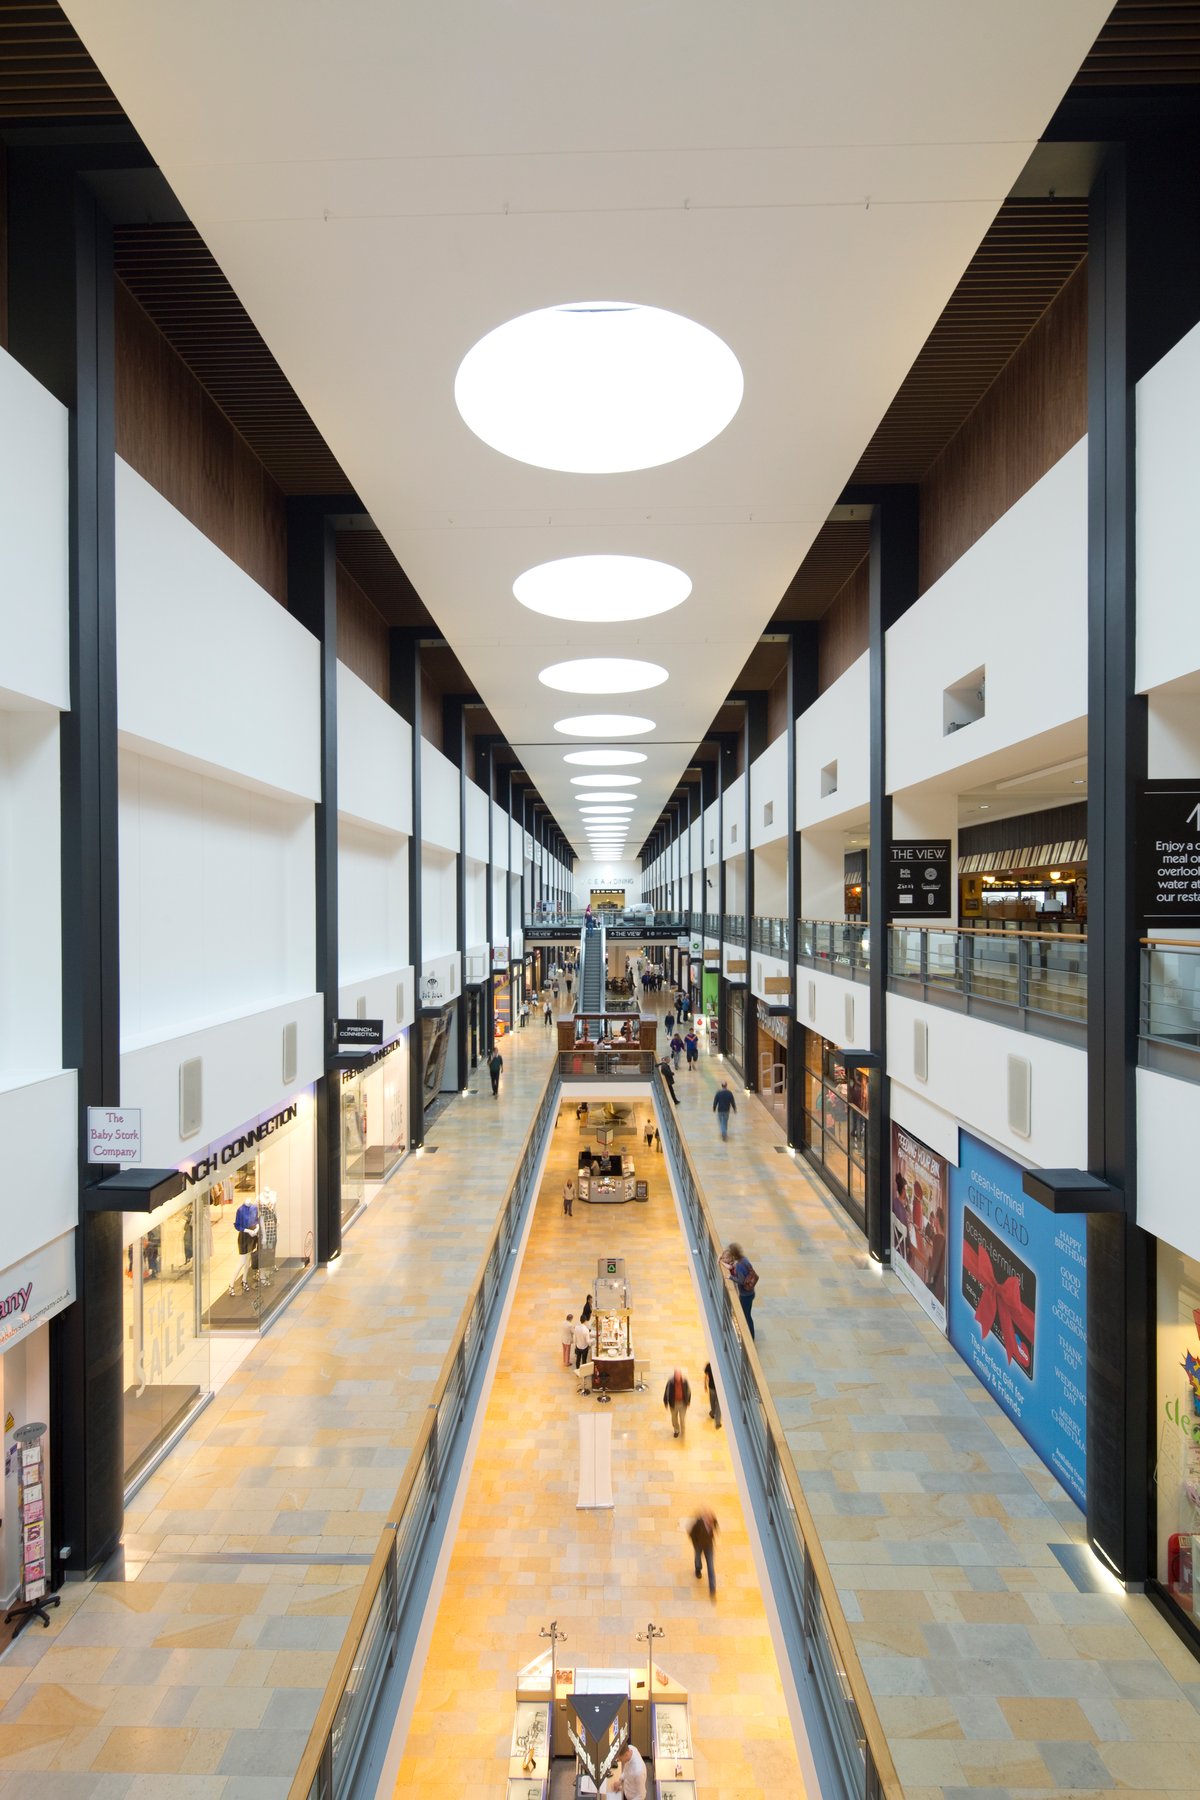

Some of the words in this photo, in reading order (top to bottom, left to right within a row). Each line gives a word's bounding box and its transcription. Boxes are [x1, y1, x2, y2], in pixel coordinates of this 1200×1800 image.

[892, 849, 914, 859] THE
[916, 849, 945, 859] VIEW
[1156, 841, 1185, 852] Enjoy
[1163, 853, 1188, 863] meal
[1158, 880, 1189, 889] water
[1156, 894, 1175, 902] our
[105, 1112, 124, 1123] The
[90, 1129, 113, 1142] Baby
[115, 1129, 139, 1140] Stork
[184, 1153, 217, 1186] NCH
[221, 1103, 297, 1165] CONNECTION
[93, 1145, 137, 1158] Company
[971, 1169, 1025, 1218] ocean-terminal
[968, 1185, 992, 1217] GIFT
[994, 1206, 1029, 1246] CARD
[1055, 1236, 1087, 1268] BIRTHDAY
[1059, 1229, 1082, 1253] HAPPY
[1060, 1266, 1081, 1288] GOOD
[1061, 1277, 1079, 1299] LUCK
[148, 1289, 173, 1335] THE
[1052, 1304, 1087, 1343] OCCASION
[1058, 1299, 1084, 1328] SPECIAL
[136, 1311, 185, 1399] SALE
[1058, 1334, 1083, 1366] THANK
[1063, 1350, 1077, 1370] YOU
[970, 1332, 981, 1352] The
[982, 1345, 1002, 1379] Perfect
[1002, 1372, 1014, 1393] Gift
[1015, 1385, 1025, 1405] for
[973, 1351, 991, 1381] Family
[991, 1375, 998, 1388] &
[998, 1381, 1022, 1418] Friends
[1063, 1386, 1077, 1406] DAY
[1051, 1409, 1087, 1455] CHRISTMA
[1060, 1406, 1081, 1436] MERRY
